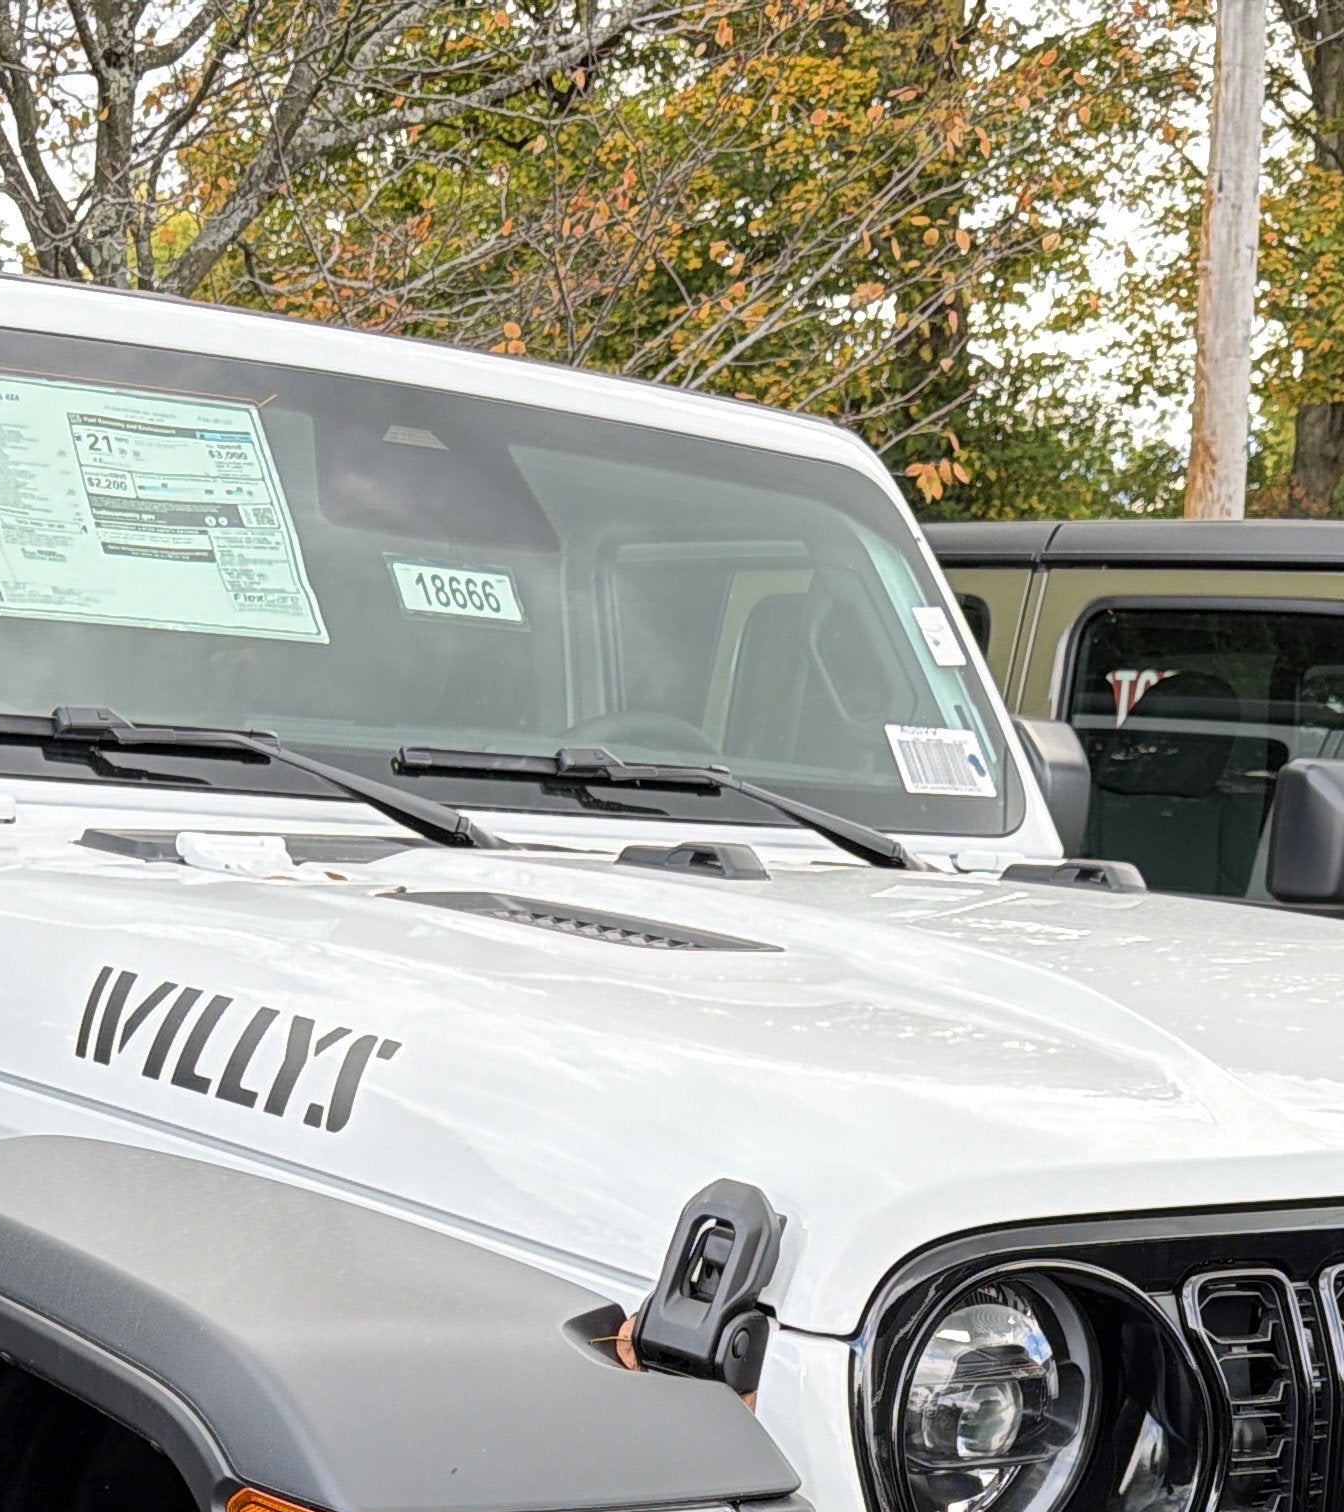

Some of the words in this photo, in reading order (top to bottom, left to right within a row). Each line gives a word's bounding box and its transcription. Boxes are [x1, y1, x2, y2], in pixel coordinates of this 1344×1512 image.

[85, 432, 113, 453] 21
[415, 572, 501, 613] 18666
[74, 965, 402, 1133] WILLYS
